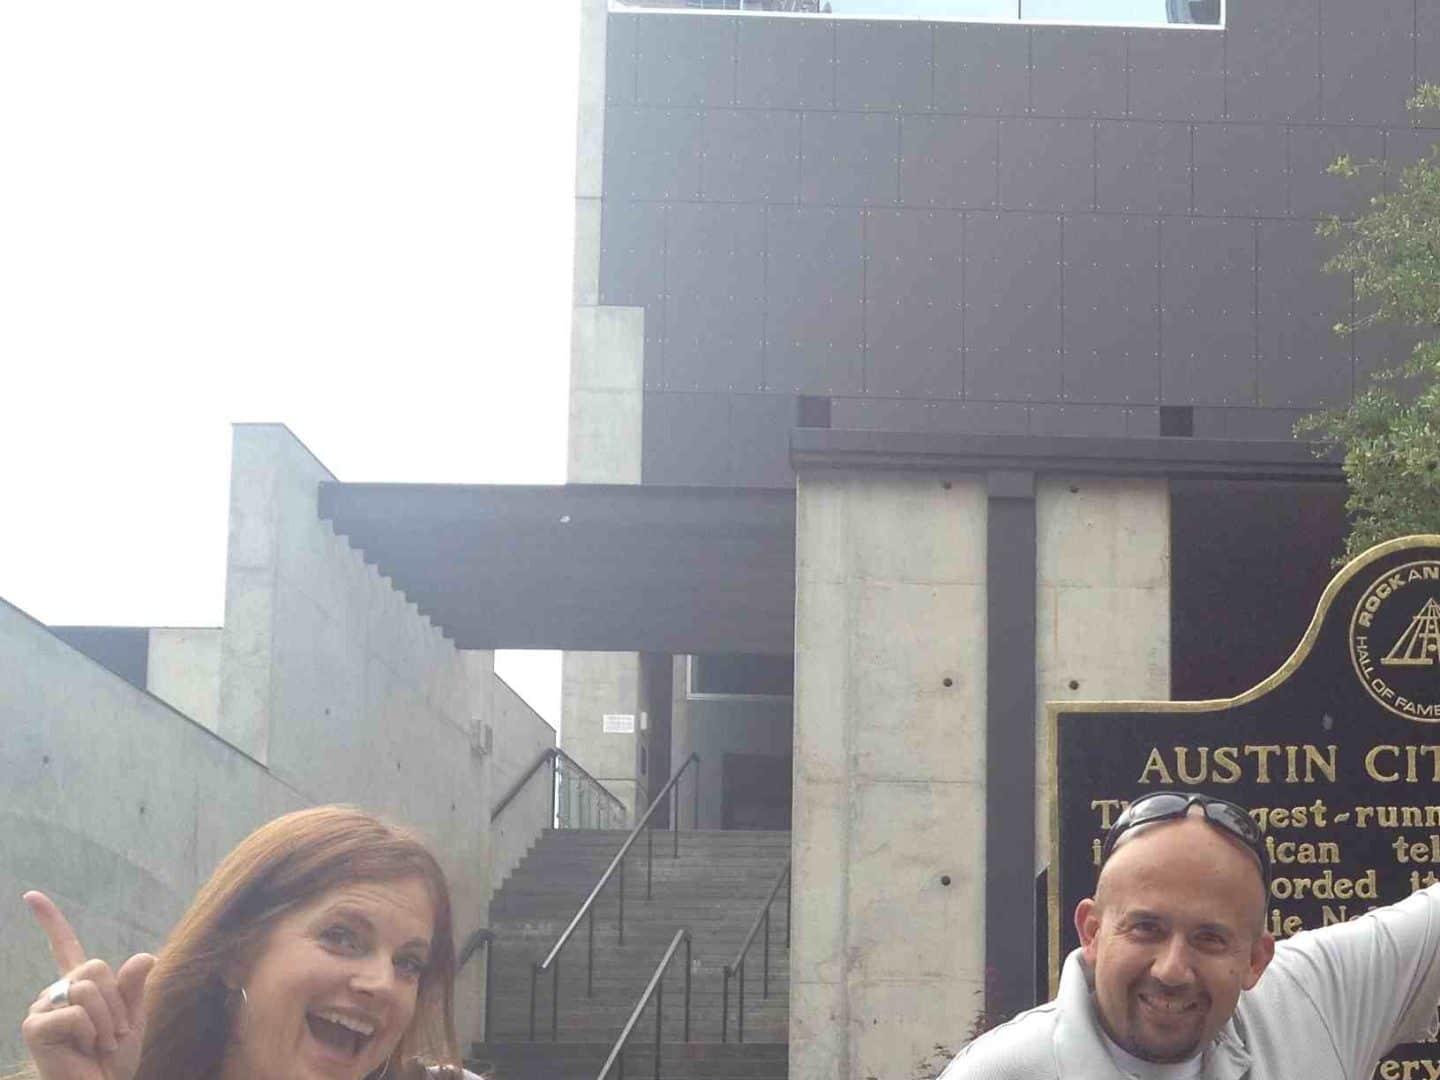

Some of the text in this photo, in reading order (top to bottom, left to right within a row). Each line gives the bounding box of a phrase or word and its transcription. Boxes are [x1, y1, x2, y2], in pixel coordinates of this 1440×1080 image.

[1358, 574, 1406, 628] ROCK
[1356, 636, 1376, 679] HALL
[1371, 678, 1394, 699] OF
[1138, 744, 1338, 784] AUSTIN
[1266, 835, 1340, 864] ican
[1271, 869, 1378, 900] orded
